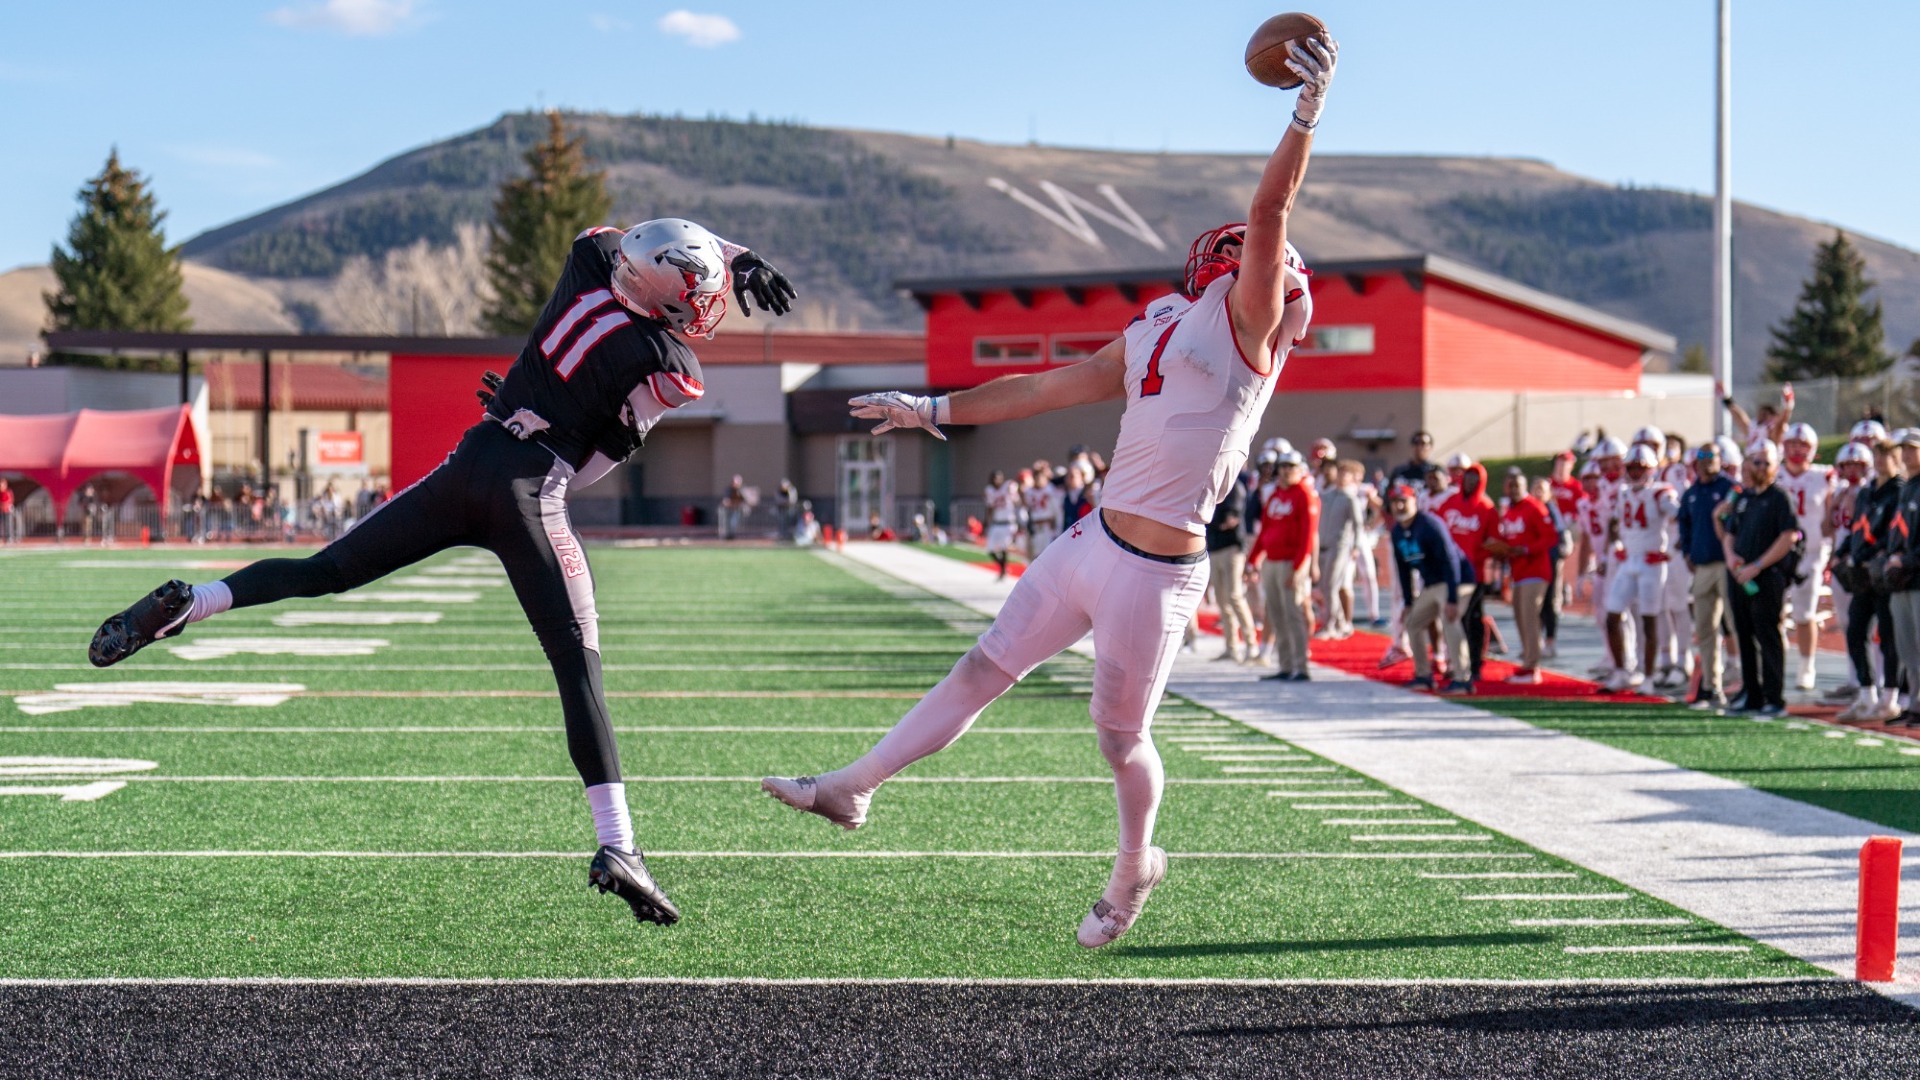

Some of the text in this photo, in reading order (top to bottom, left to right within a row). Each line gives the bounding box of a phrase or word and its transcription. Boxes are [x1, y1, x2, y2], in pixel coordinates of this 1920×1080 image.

[985, 177, 1166, 250] W
[540, 287, 633, 382] 11
[1153, 315, 1173, 327] CSU
[1140, 319, 1181, 398] 1
[550, 527, 585, 579] 7723
